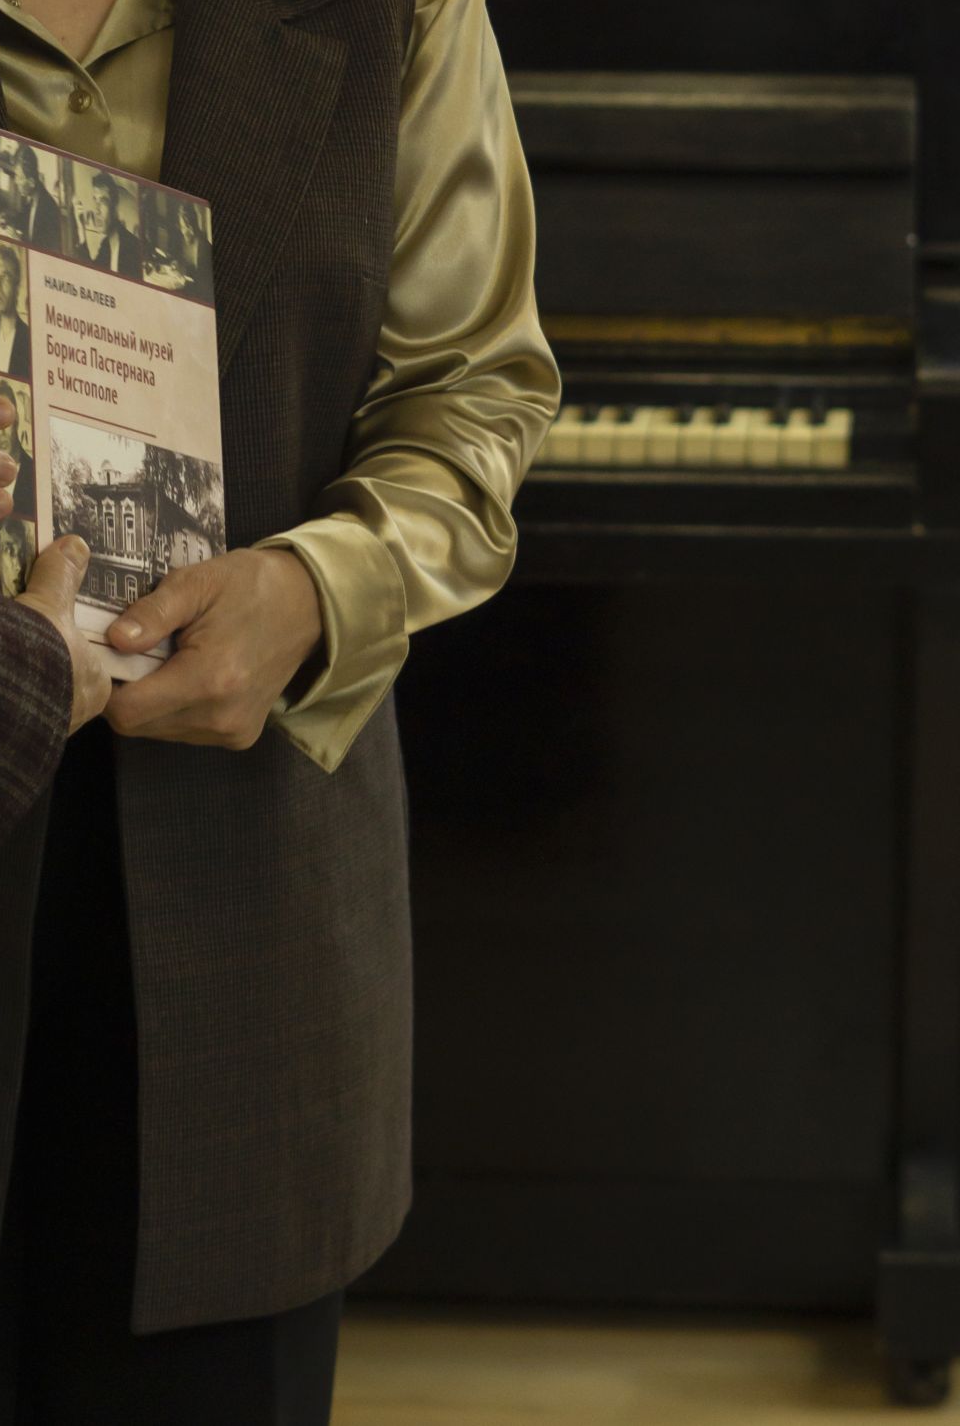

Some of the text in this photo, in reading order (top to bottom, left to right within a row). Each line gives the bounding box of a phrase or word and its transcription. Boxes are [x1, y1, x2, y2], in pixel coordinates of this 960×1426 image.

[44, 275, 117, 309] НАИЛЬ ВАЛЕЕВ
[45, 303, 174, 364] Мемориальный музей
[46, 333, 156, 387] Бориса Пастернака
[47, 367, 119, 405] в Чистополе
